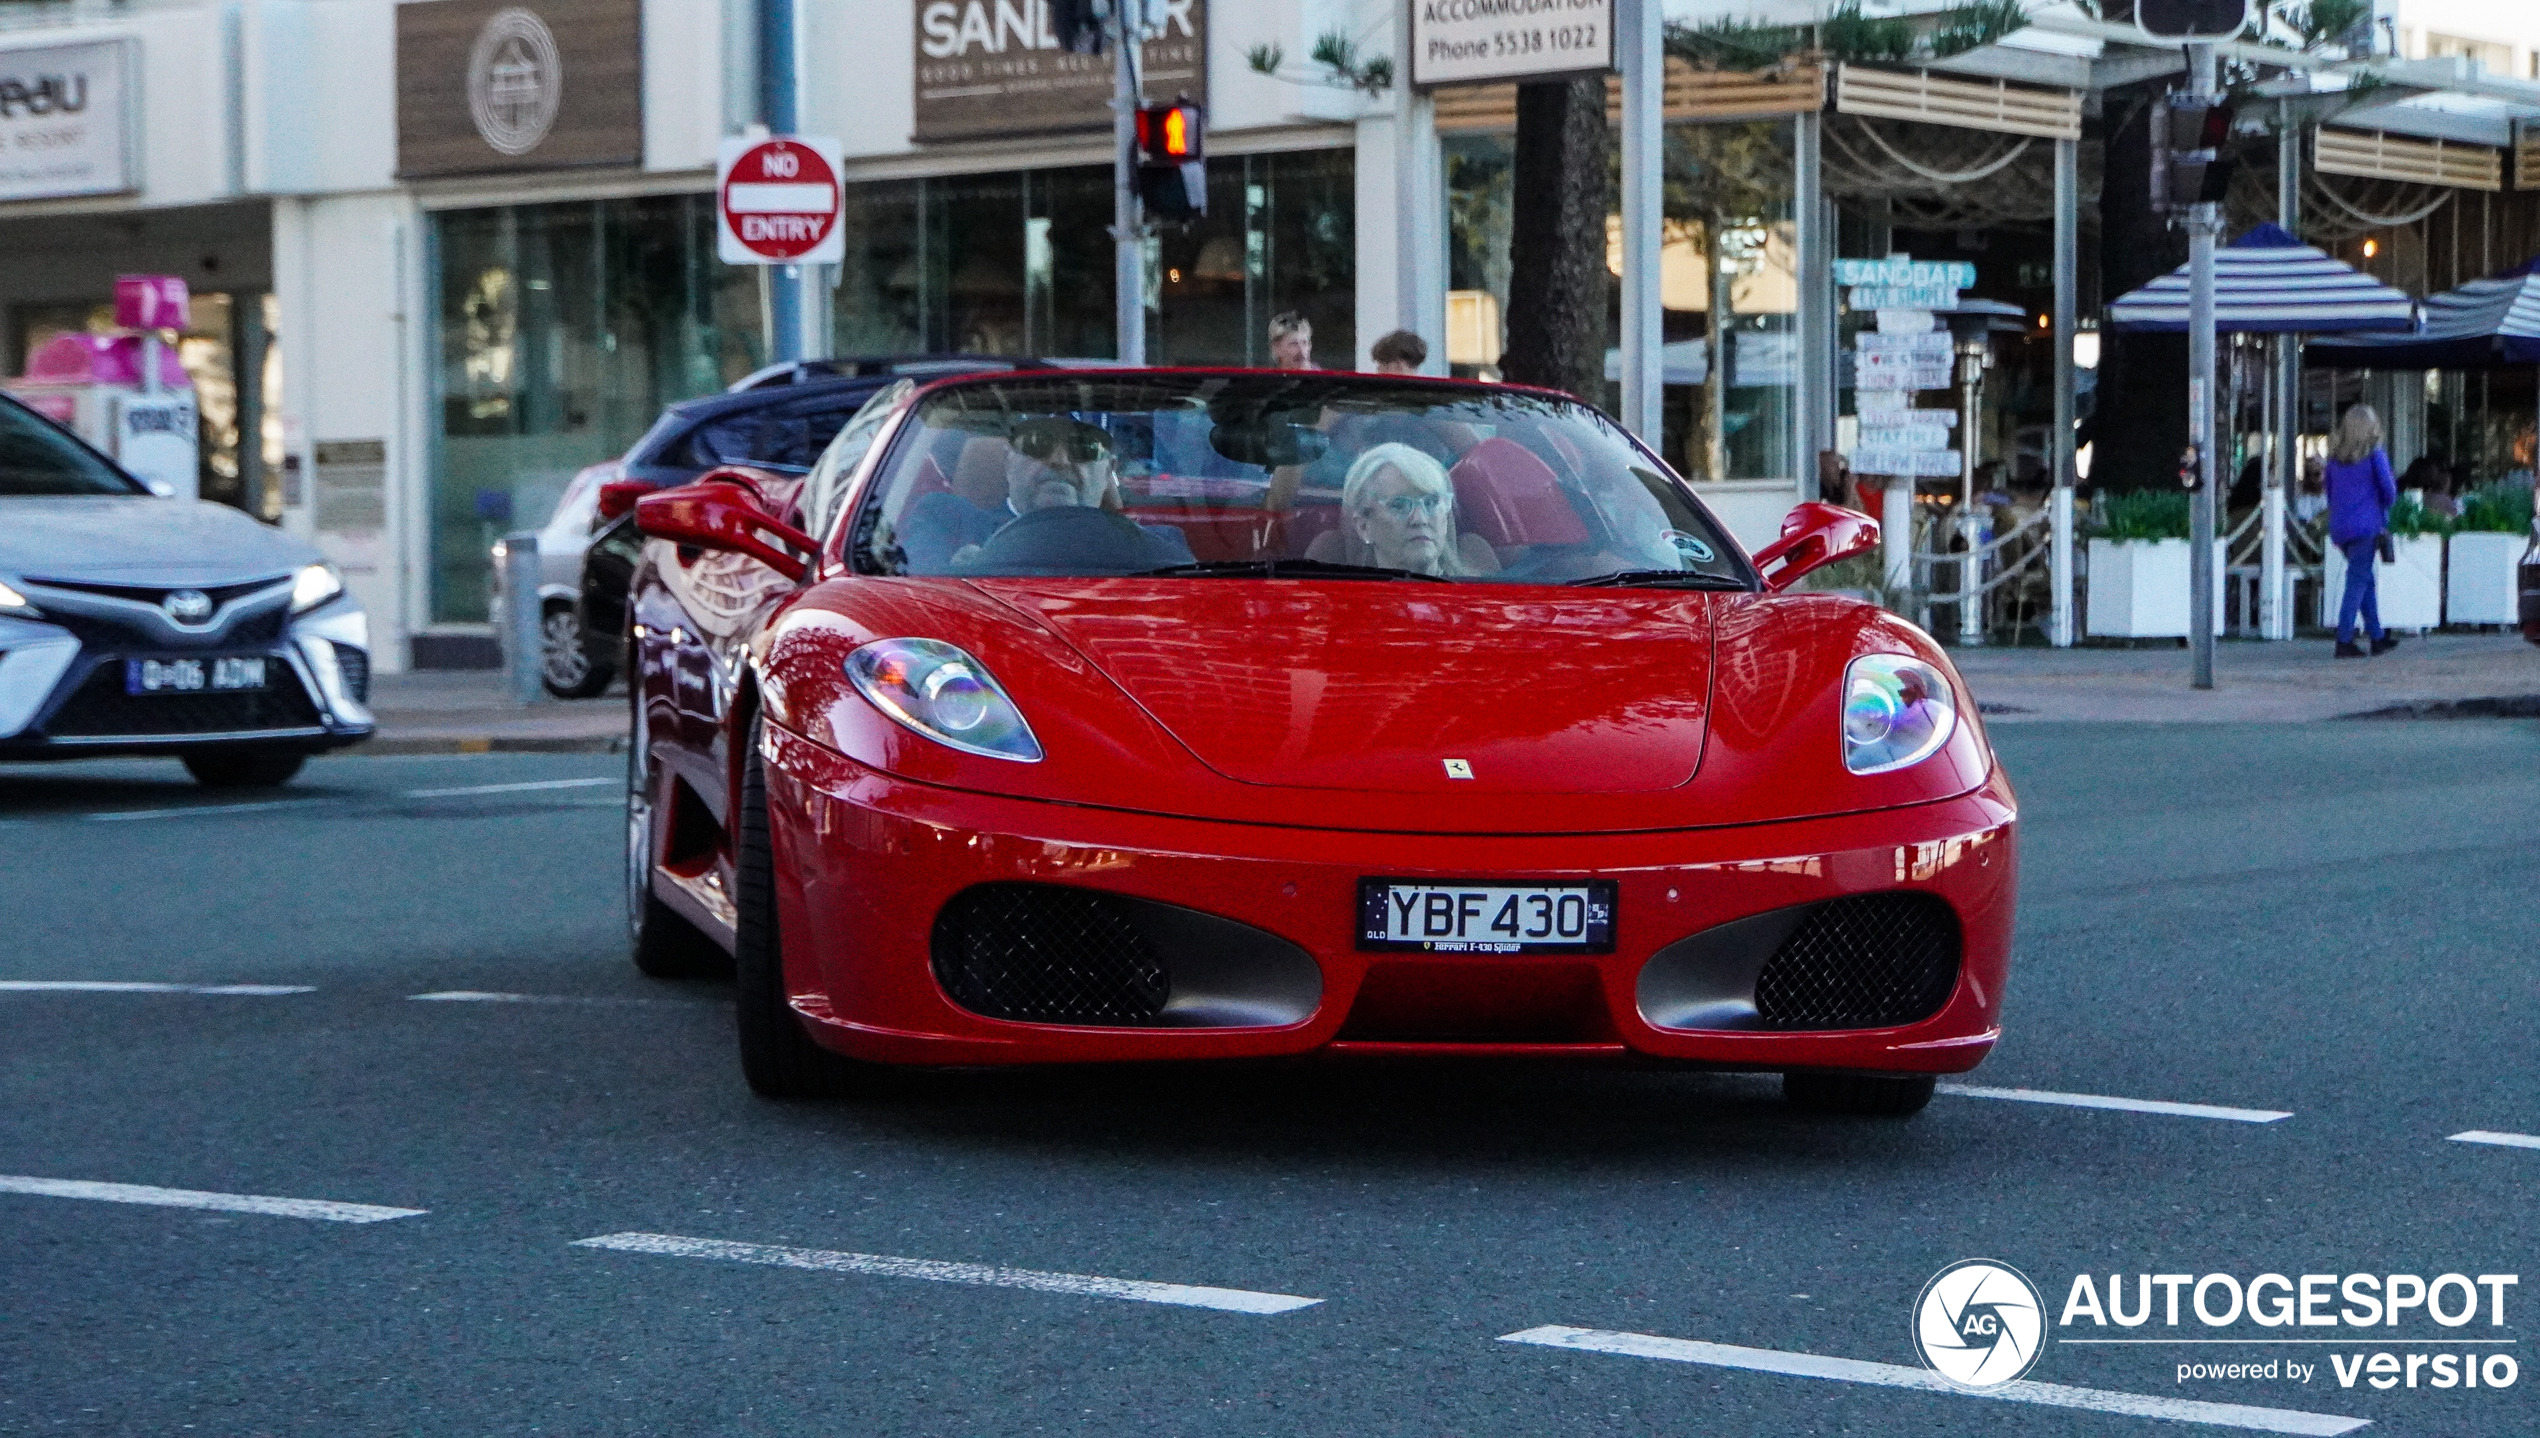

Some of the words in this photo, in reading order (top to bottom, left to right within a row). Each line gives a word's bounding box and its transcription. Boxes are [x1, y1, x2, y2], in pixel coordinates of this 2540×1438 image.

[921, 0, 1195, 58] SANR
[1427, 38, 1488, 62] Phone
[1493, 29, 1543, 56] 5538
[1549, 24, 1597, 50] 1022
[762, 151, 799, 178] NO
[741, 214, 826, 241] ENTRY
[1844, 261, 1963, 288] SANDBAR
[1434, 942, 1467, 951] Ferrari
[1470, 943, 1492, 951] F-430
[1494, 943, 1521, 954] Spider
